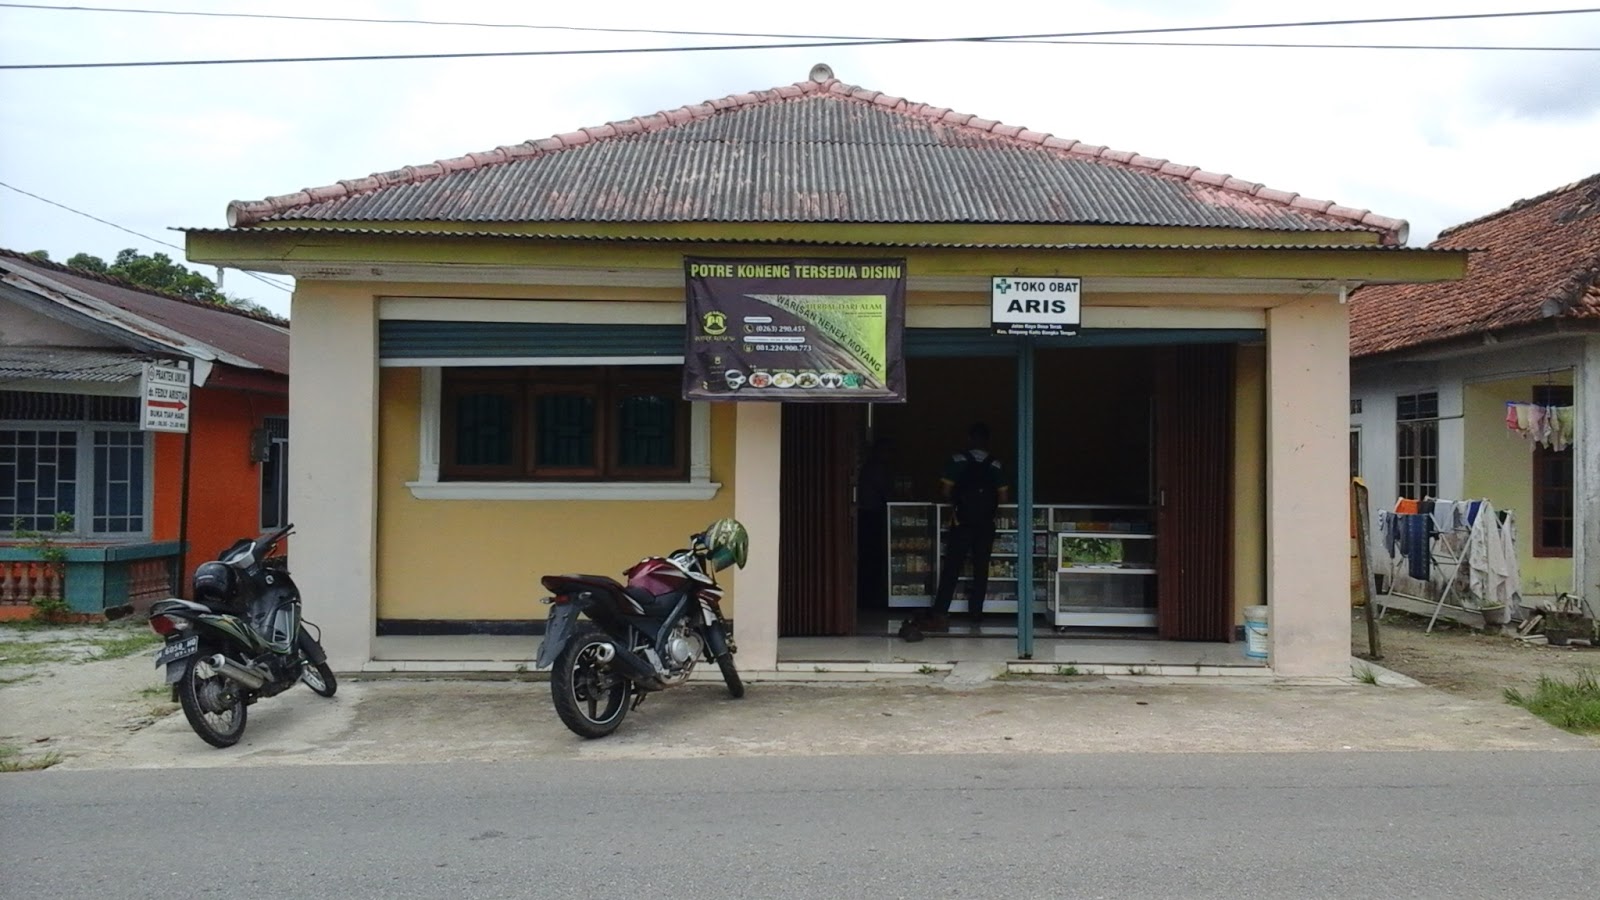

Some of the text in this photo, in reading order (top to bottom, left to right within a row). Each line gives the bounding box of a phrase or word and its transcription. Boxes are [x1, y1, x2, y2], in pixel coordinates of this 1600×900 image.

[690, 264, 901, 279] POTRE KONENG TERSEDIA DISINI
[1014, 281, 1079, 293] TOKO OBAT
[1007, 299, 1066, 314] ARIS
[756, 324, 777, 333] (0263)
[776, 294, 882, 372] WARISAN NENEK MOYANG
